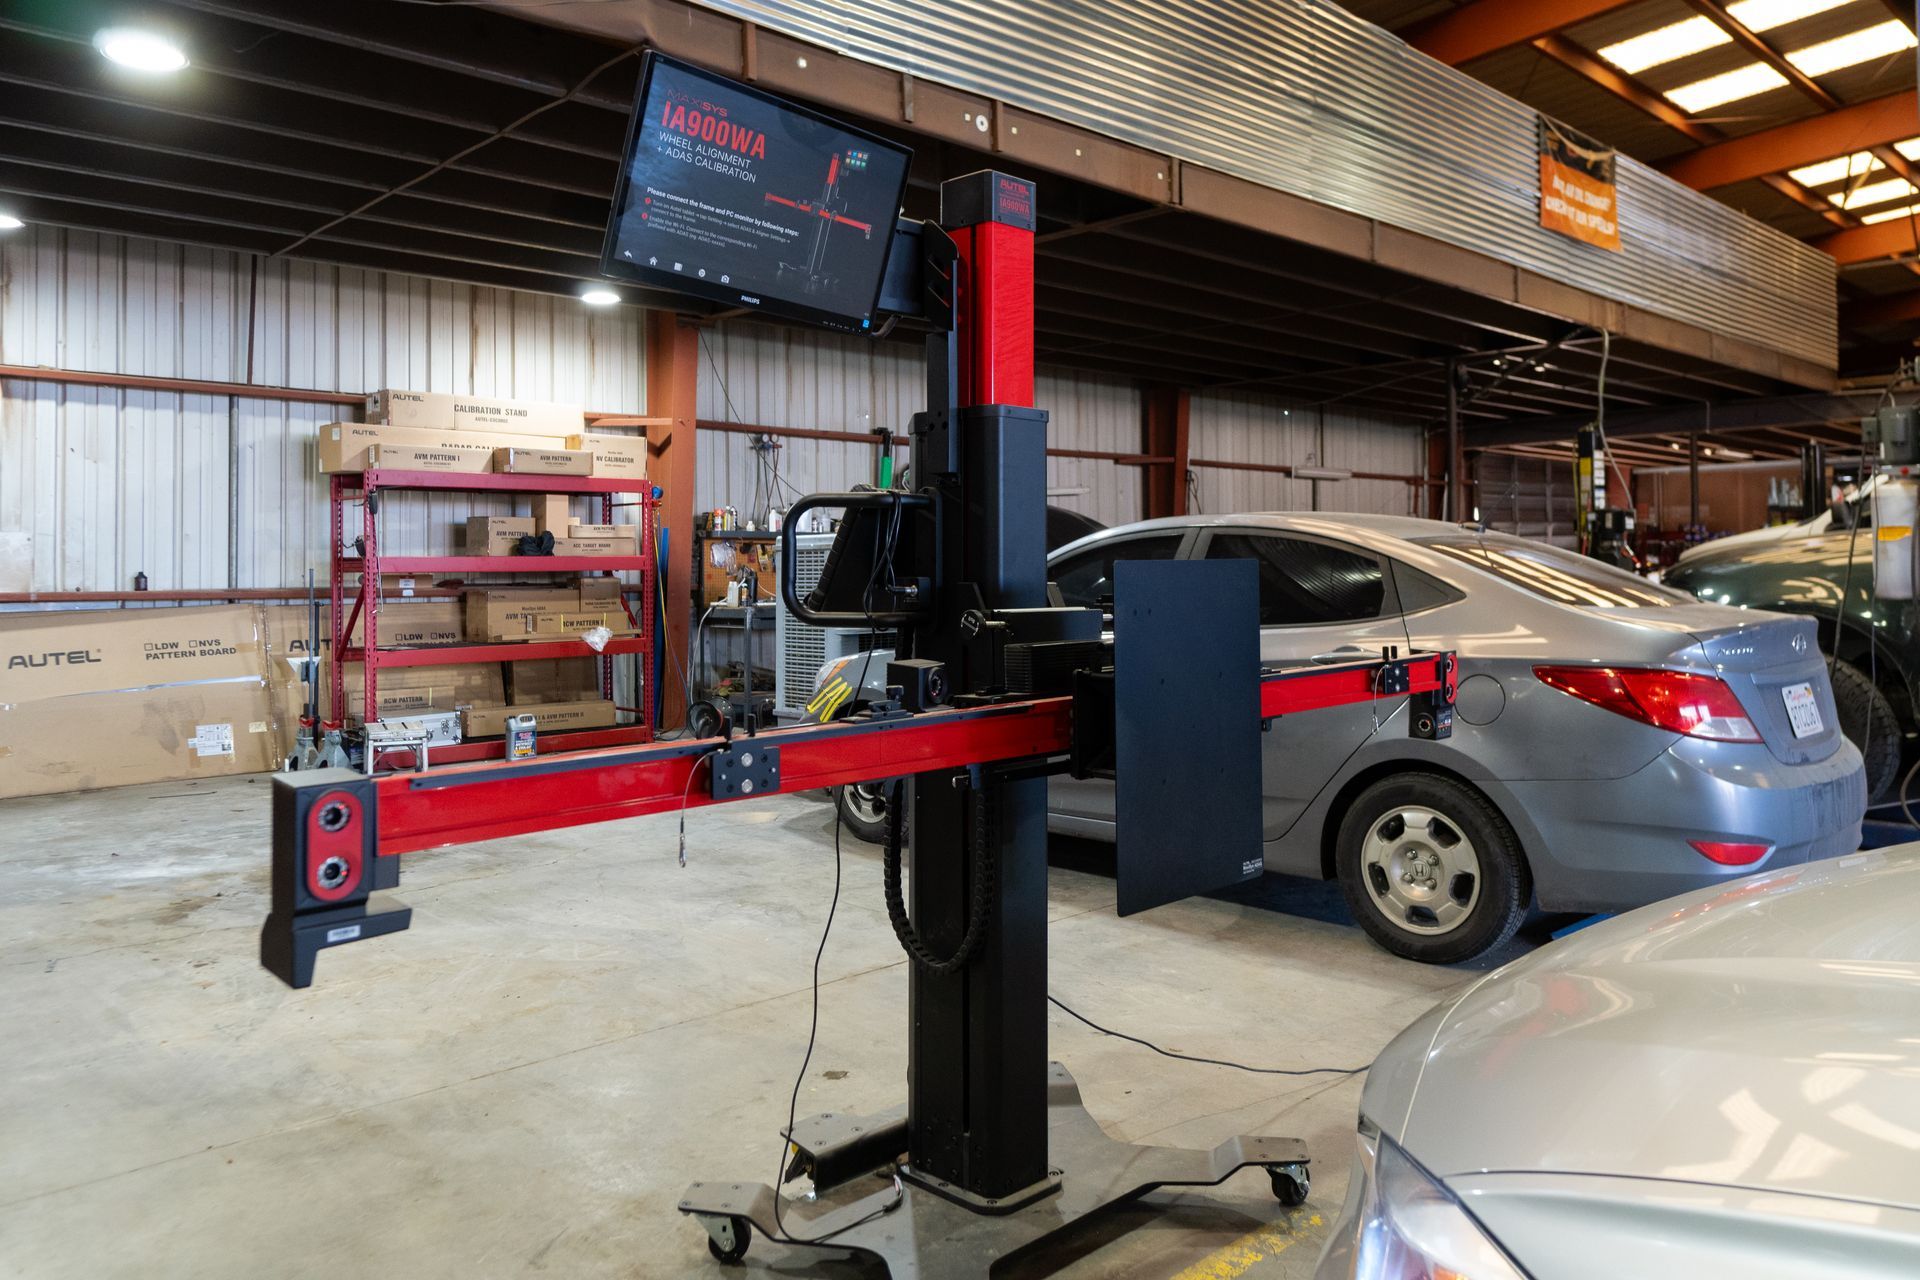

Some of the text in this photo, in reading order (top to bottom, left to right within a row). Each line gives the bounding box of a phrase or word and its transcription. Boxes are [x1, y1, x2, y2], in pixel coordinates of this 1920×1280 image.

[666, 89, 728, 117] MAXISYS
[662, 100, 765, 159] IA900WA
[659, 131, 752, 169] WHEEL ALIGNMENT
[665, 147, 692, 163] ADAS
[694, 155, 757, 184] CALIBRATION
[646, 186, 667, 198] Please
[666, 193, 689, 204] connect
[689, 199, 699, 208] the
[698, 201, 715, 212] frame
[715, 207, 726, 216] and
[725, 209, 735, 218] PC
[734, 213, 755, 224] monitor
[754, 218, 762, 227] by
[761, 220, 785, 234] following
[741, 295, 760, 305] PHILIPS
[392, 393, 528, 417] AUTEL CALIBRATION STAND
[414, 453, 429, 461] AVM
[429, 454, 457, 462] PATTERN
[604, 456, 634, 464] CALIBRATOR
[575, 619, 600, 627] PATTERN
[154, 639, 222, 650] LDW NVS
[403, 632, 457, 641] LDW NVS
[8, 650, 102, 669] AUTEL
[146, 647, 238, 661] PATTERN BOARD
